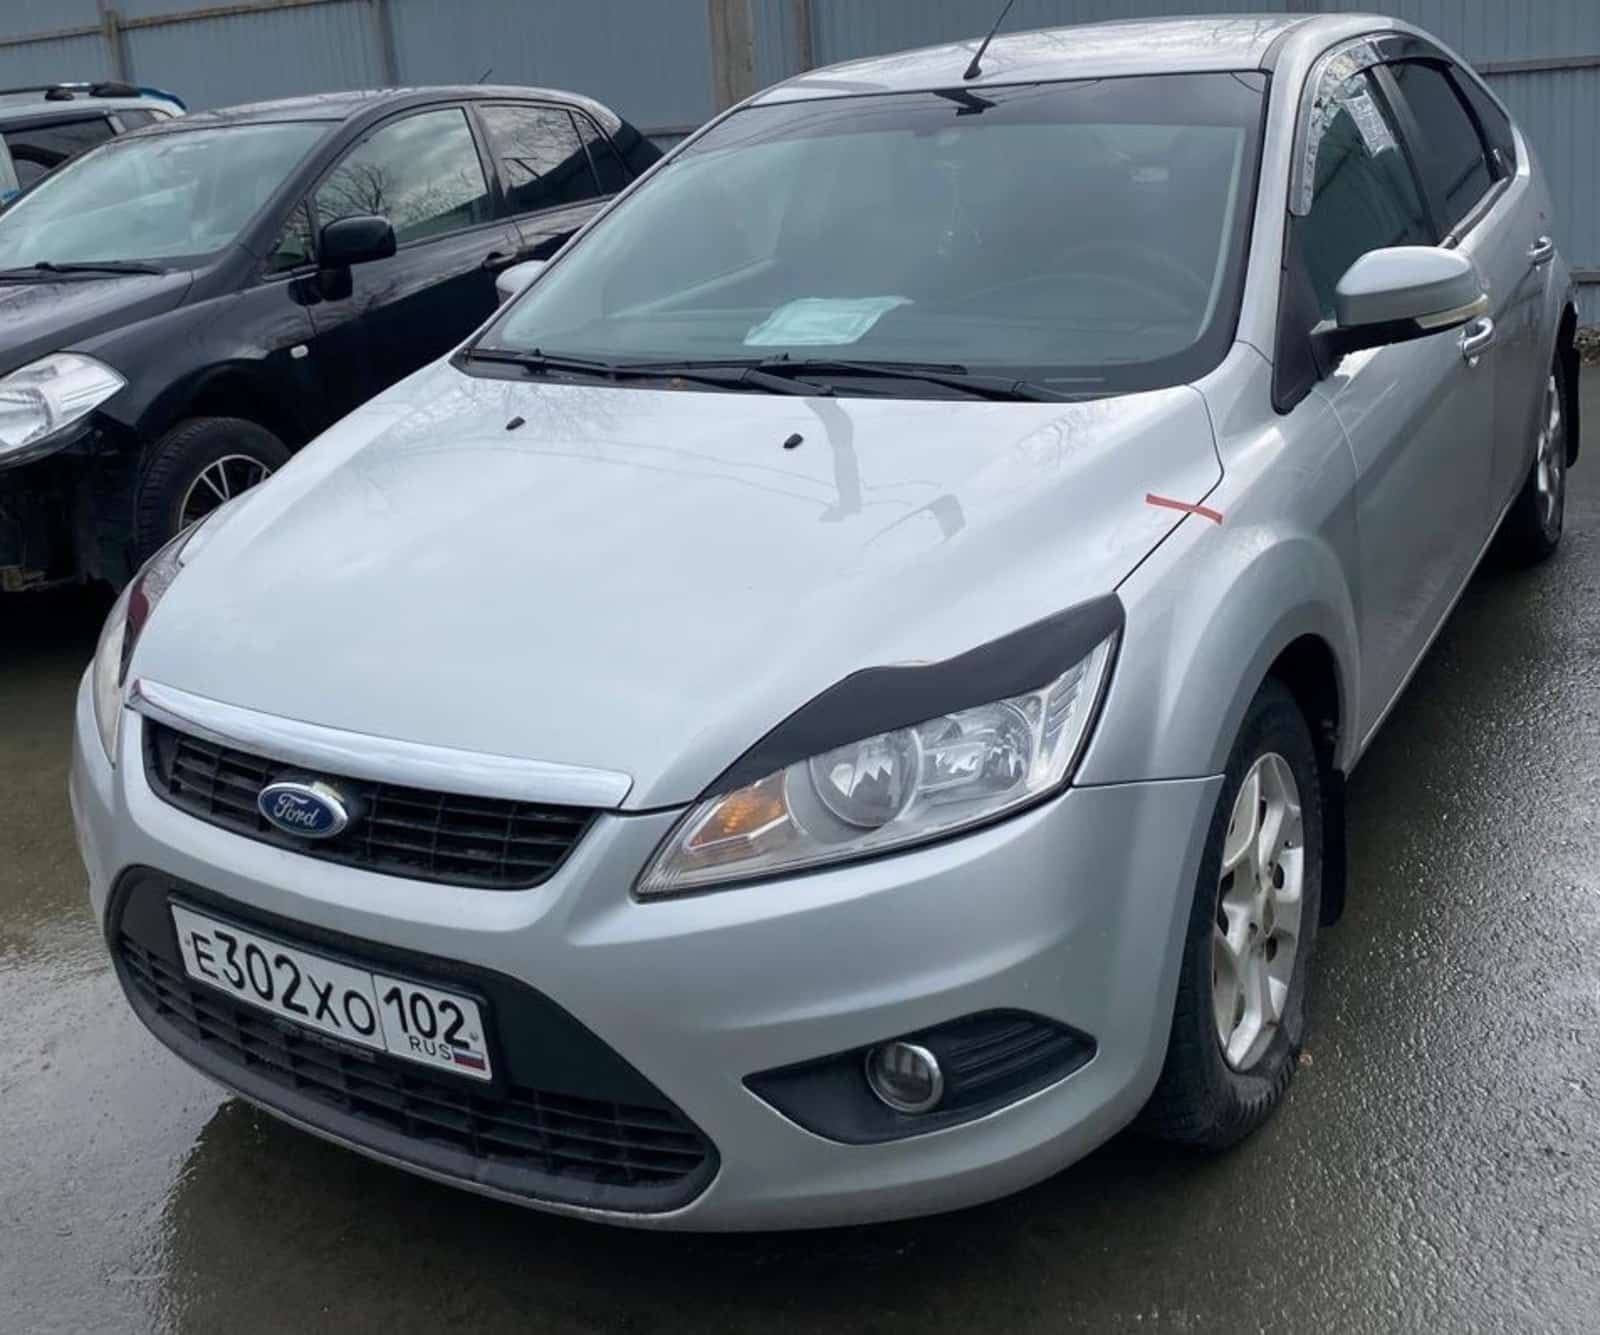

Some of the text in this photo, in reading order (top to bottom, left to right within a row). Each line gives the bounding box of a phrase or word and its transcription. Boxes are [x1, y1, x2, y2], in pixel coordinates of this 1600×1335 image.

[274, 793, 320, 827] Ford
[384, 986, 471, 1050] 102
[408, 1034, 453, 1061] RUS
